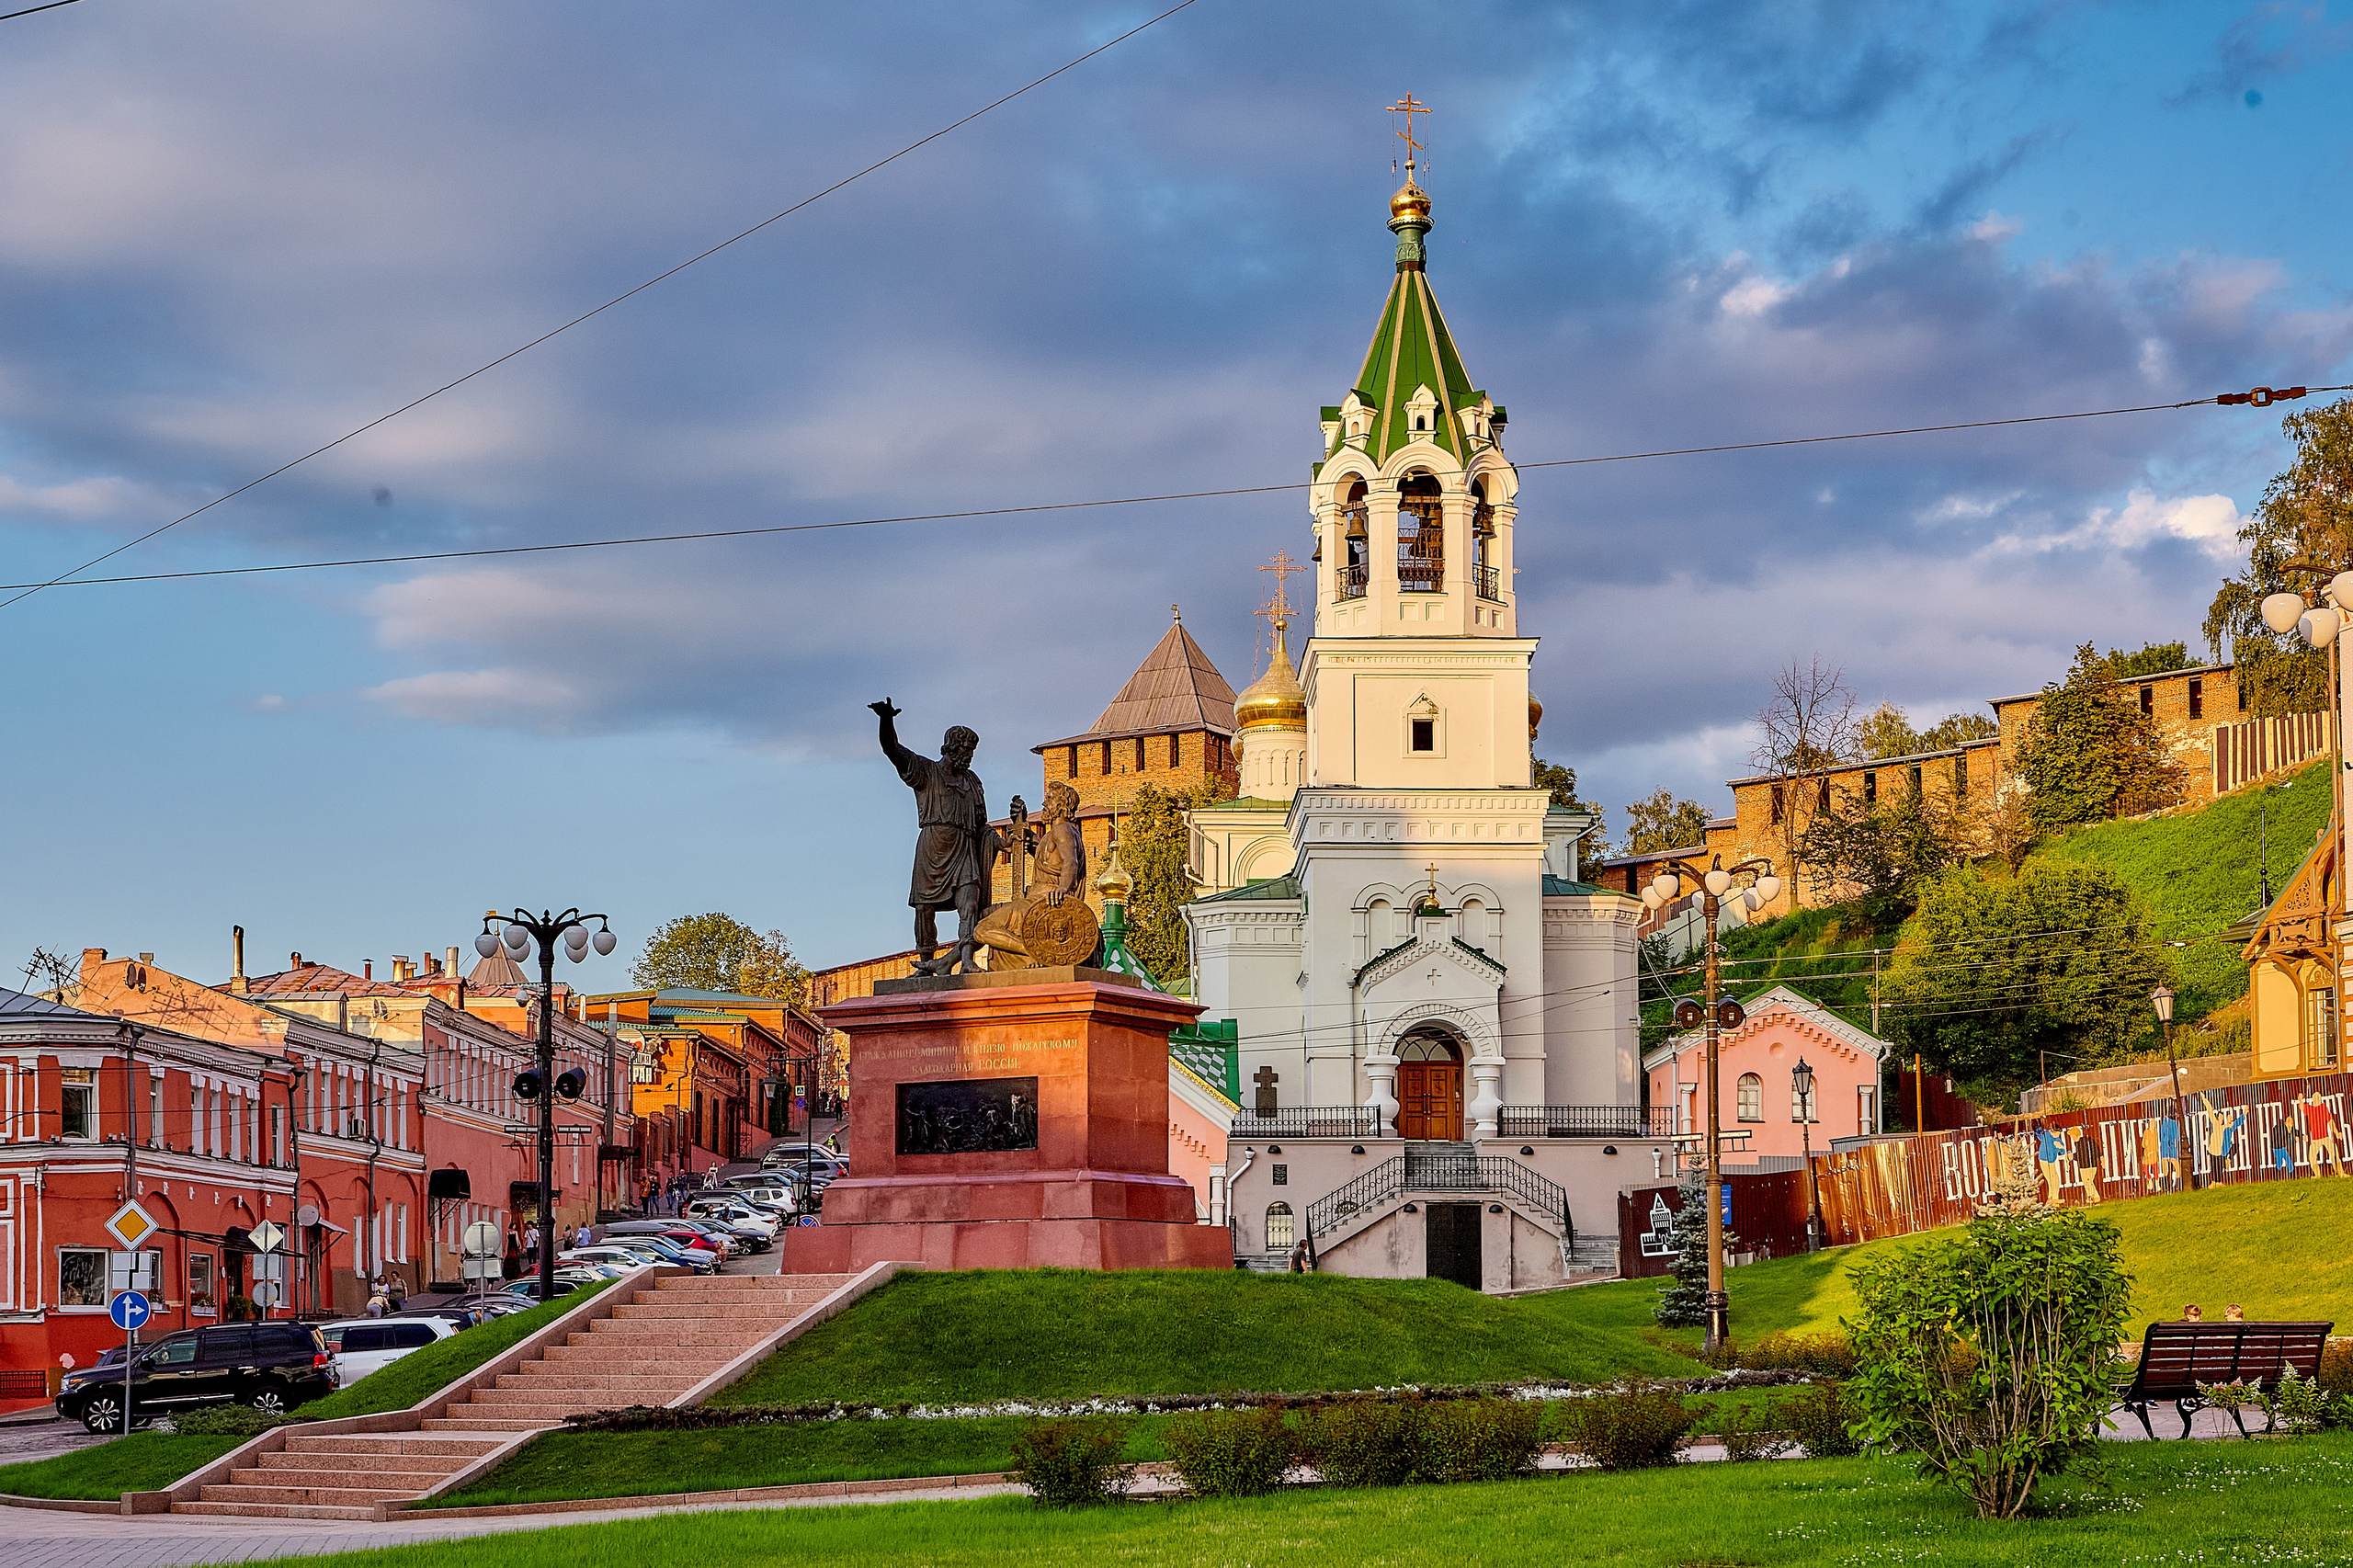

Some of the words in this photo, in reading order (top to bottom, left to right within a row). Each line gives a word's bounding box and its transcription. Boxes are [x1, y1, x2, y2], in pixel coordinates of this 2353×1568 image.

[962, 1044, 971, 1055] И
[973, 1042, 1006, 1054] КНЯЗЮ
[1012, 1039, 1078, 1052] ПОЖАРСКОМУ
